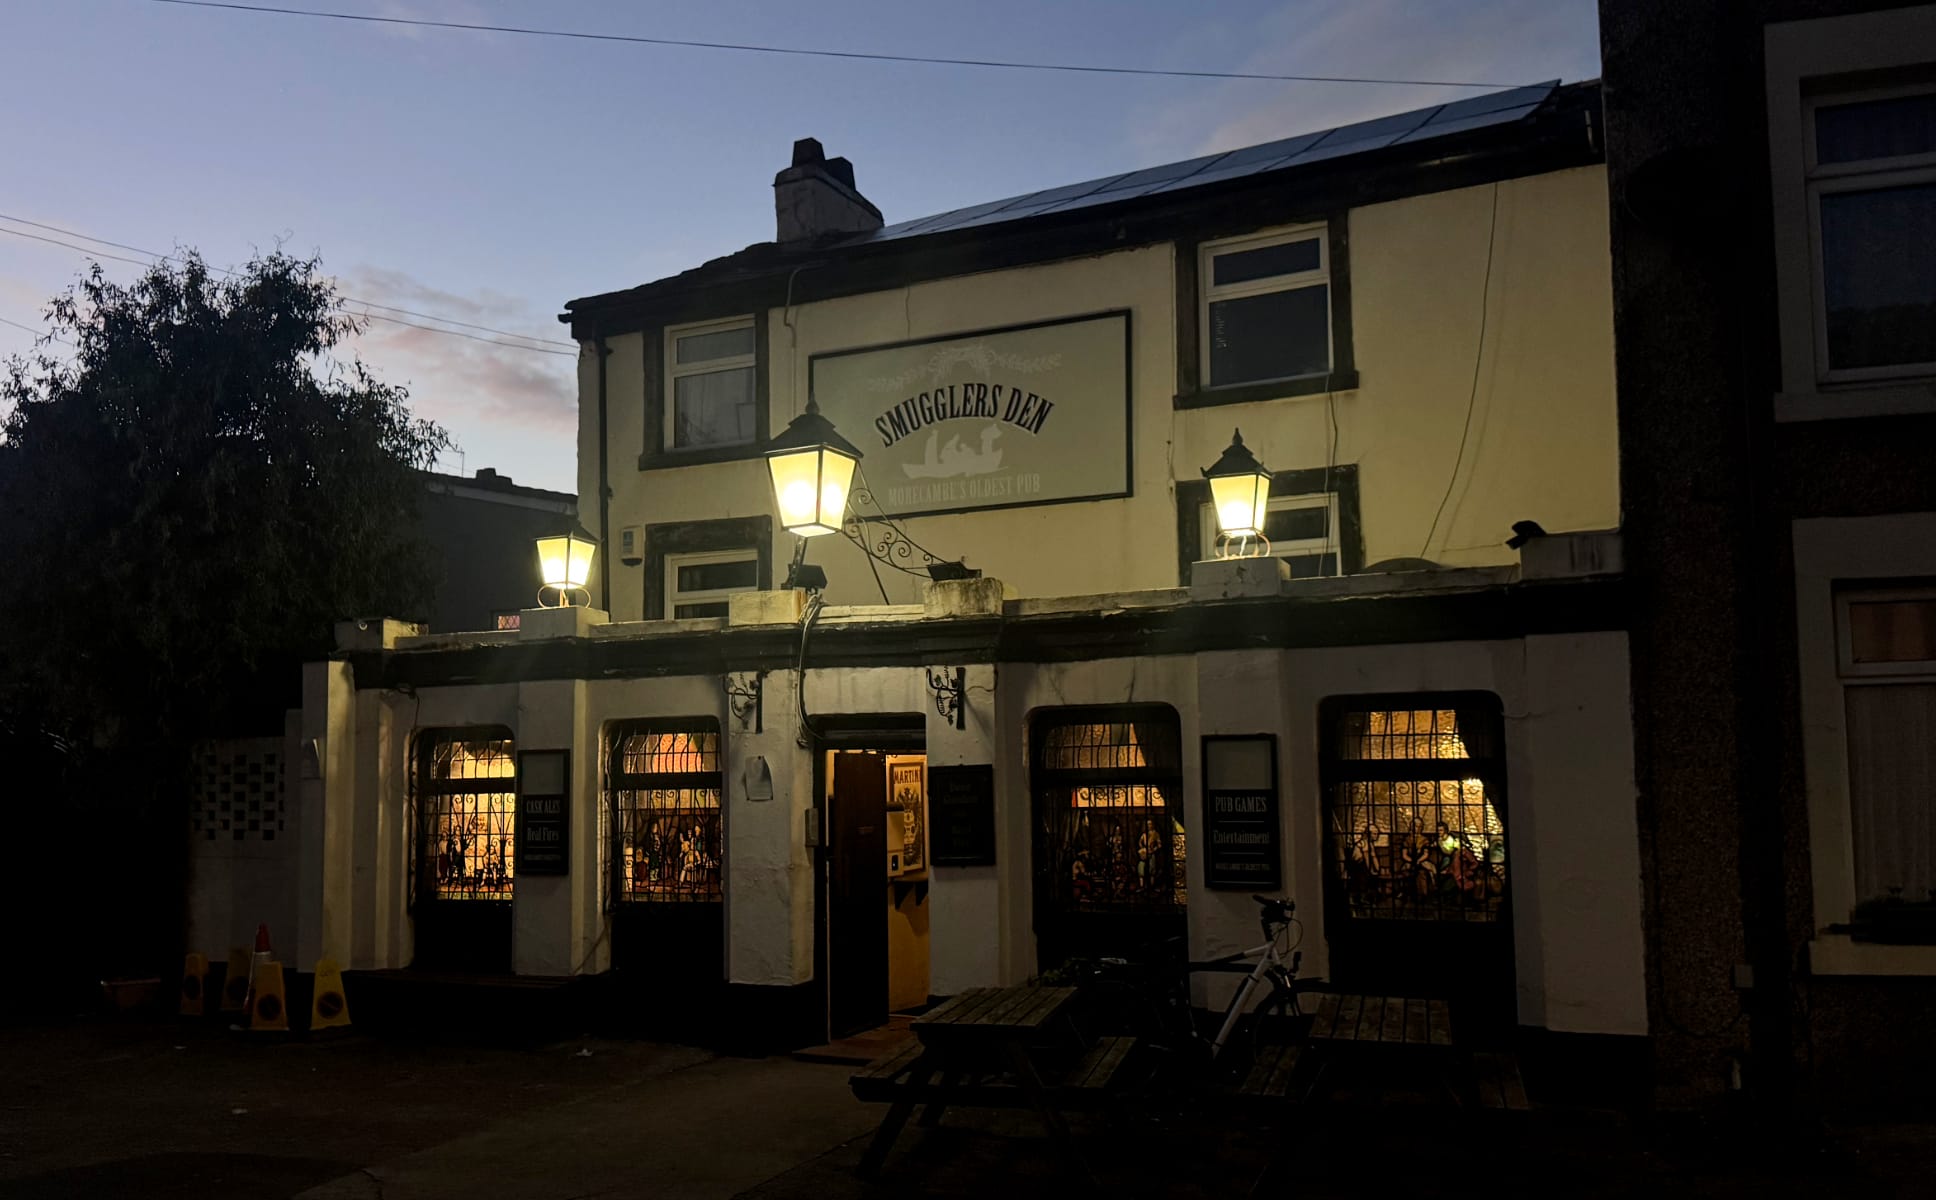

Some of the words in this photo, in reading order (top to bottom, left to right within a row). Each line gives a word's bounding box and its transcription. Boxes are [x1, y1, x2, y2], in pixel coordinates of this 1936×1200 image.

[875, 383, 1003, 448] SMUGGLERS
[1001, 388, 1055, 434] DEN
[969, 476, 1012, 498] OLDEST
[1016, 473, 1040, 496] PUB
[526, 799, 543, 814] CASK
[544, 799, 561, 814] ALES
[1215, 796, 1233, 813] PUB
[1234, 796, 1268, 813] GAMES
[1212, 829, 1270, 845] Entertainment
